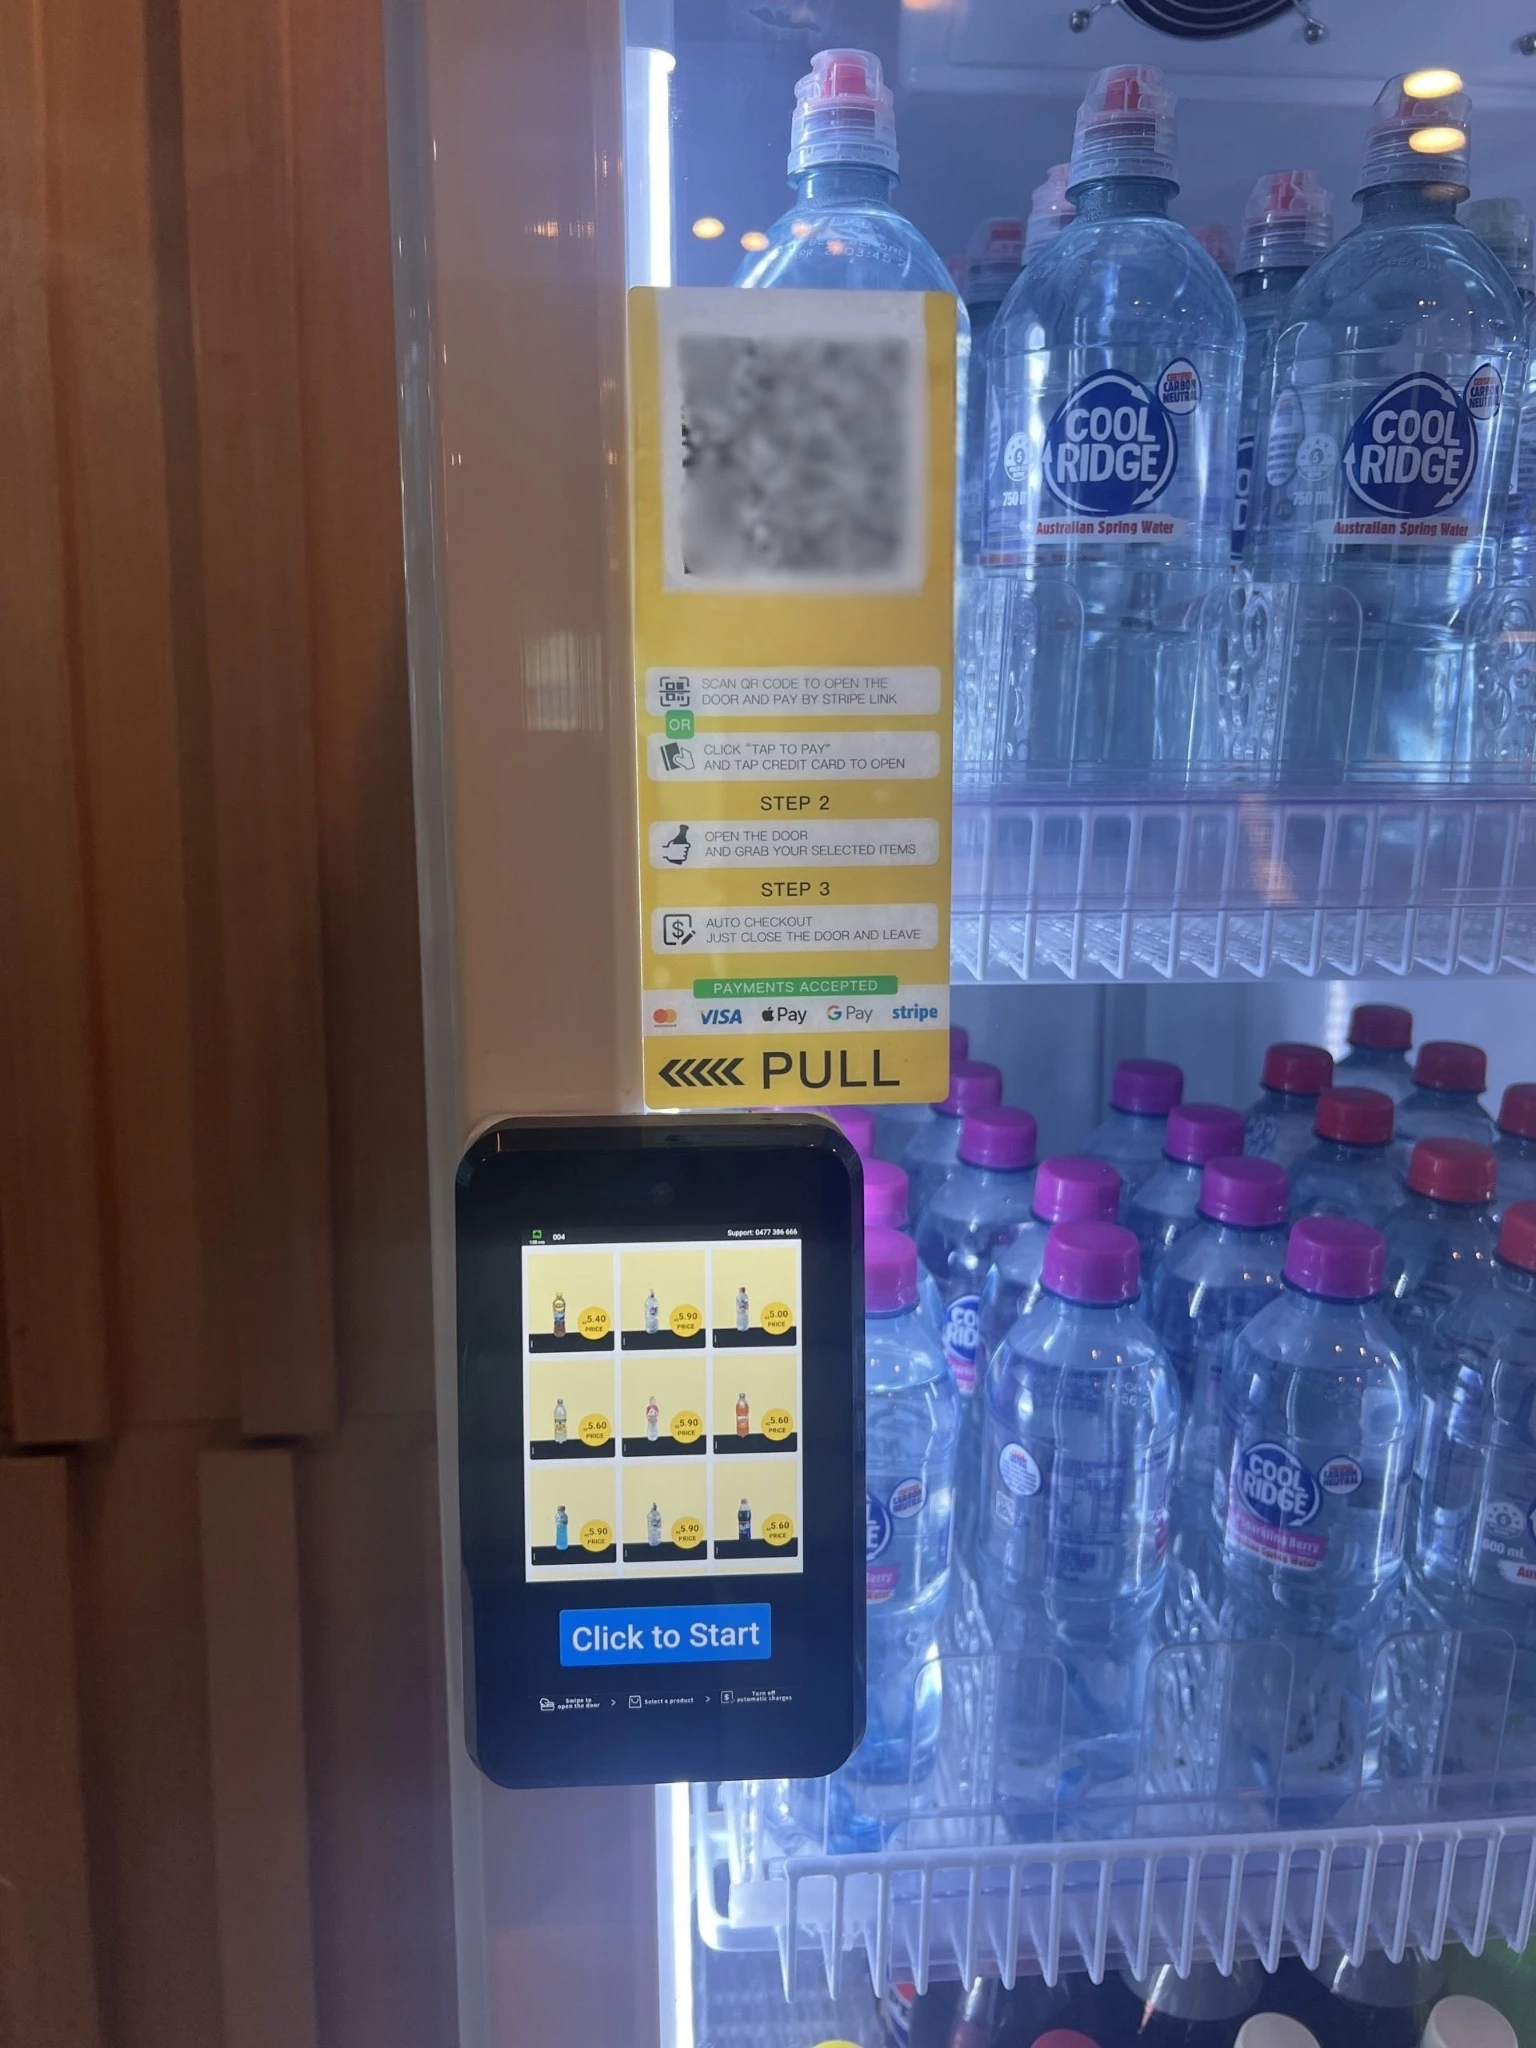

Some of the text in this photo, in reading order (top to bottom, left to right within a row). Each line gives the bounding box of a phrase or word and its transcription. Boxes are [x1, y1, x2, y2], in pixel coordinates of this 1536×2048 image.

[1065, 406, 1156, 442] COOL
[1372, 410, 1460, 446] COOL
[1057, 443, 1160, 483] RIDGE
[1360, 445, 1463, 485] RIDGE
[1036, 519, 1174, 535] Australian Spring Water
[1333, 521, 1469, 537] Australian Spring Water
[702, 677, 888, 690] SCAN QR CODE TO OPEN THE
[702, 693, 898, 706] DOOR AND PAY BY STRIPE LINK
[669, 719, 691, 731] OR
[704, 744, 741, 755] CLICK
[781, 743, 797, 754] TO
[704, 758, 905, 771] AND TAP CREDIT CARD TO OPEN
[760, 795, 830, 811] STEP 2
[705, 830, 808, 842] OPEN THE DOOR
[705, 844, 916, 857] AND GRAB YOUR SELECTED ITEMS
[761, 881, 830, 897] STEP 3
[706, 916, 812, 928] AUTO CHECKOUT
[706, 929, 921, 943] JUST CLOSE THE DOOR AND LEAVE
[713, 980, 878, 994] PAYMENTS ACCEPTED
[700, 1009, 743, 1025] VISA
[777, 1007, 807, 1025] Pay
[892, 1003, 938, 1022] stripe
[763, 1049, 900, 1089] PULL
[552, 1233, 566, 1241] 004
[727, 1229, 754, 1237] Support:
[755, 1228, 771, 1236] 0477
[951, 1307, 977, 1327] CO
[943, 1322, 977, 1348] RID
[1249, 1454, 1307, 1495] COOL
[1243, 1470, 1309, 1517] RIDGE
[572, 1622, 760, 1652] Click to Start
